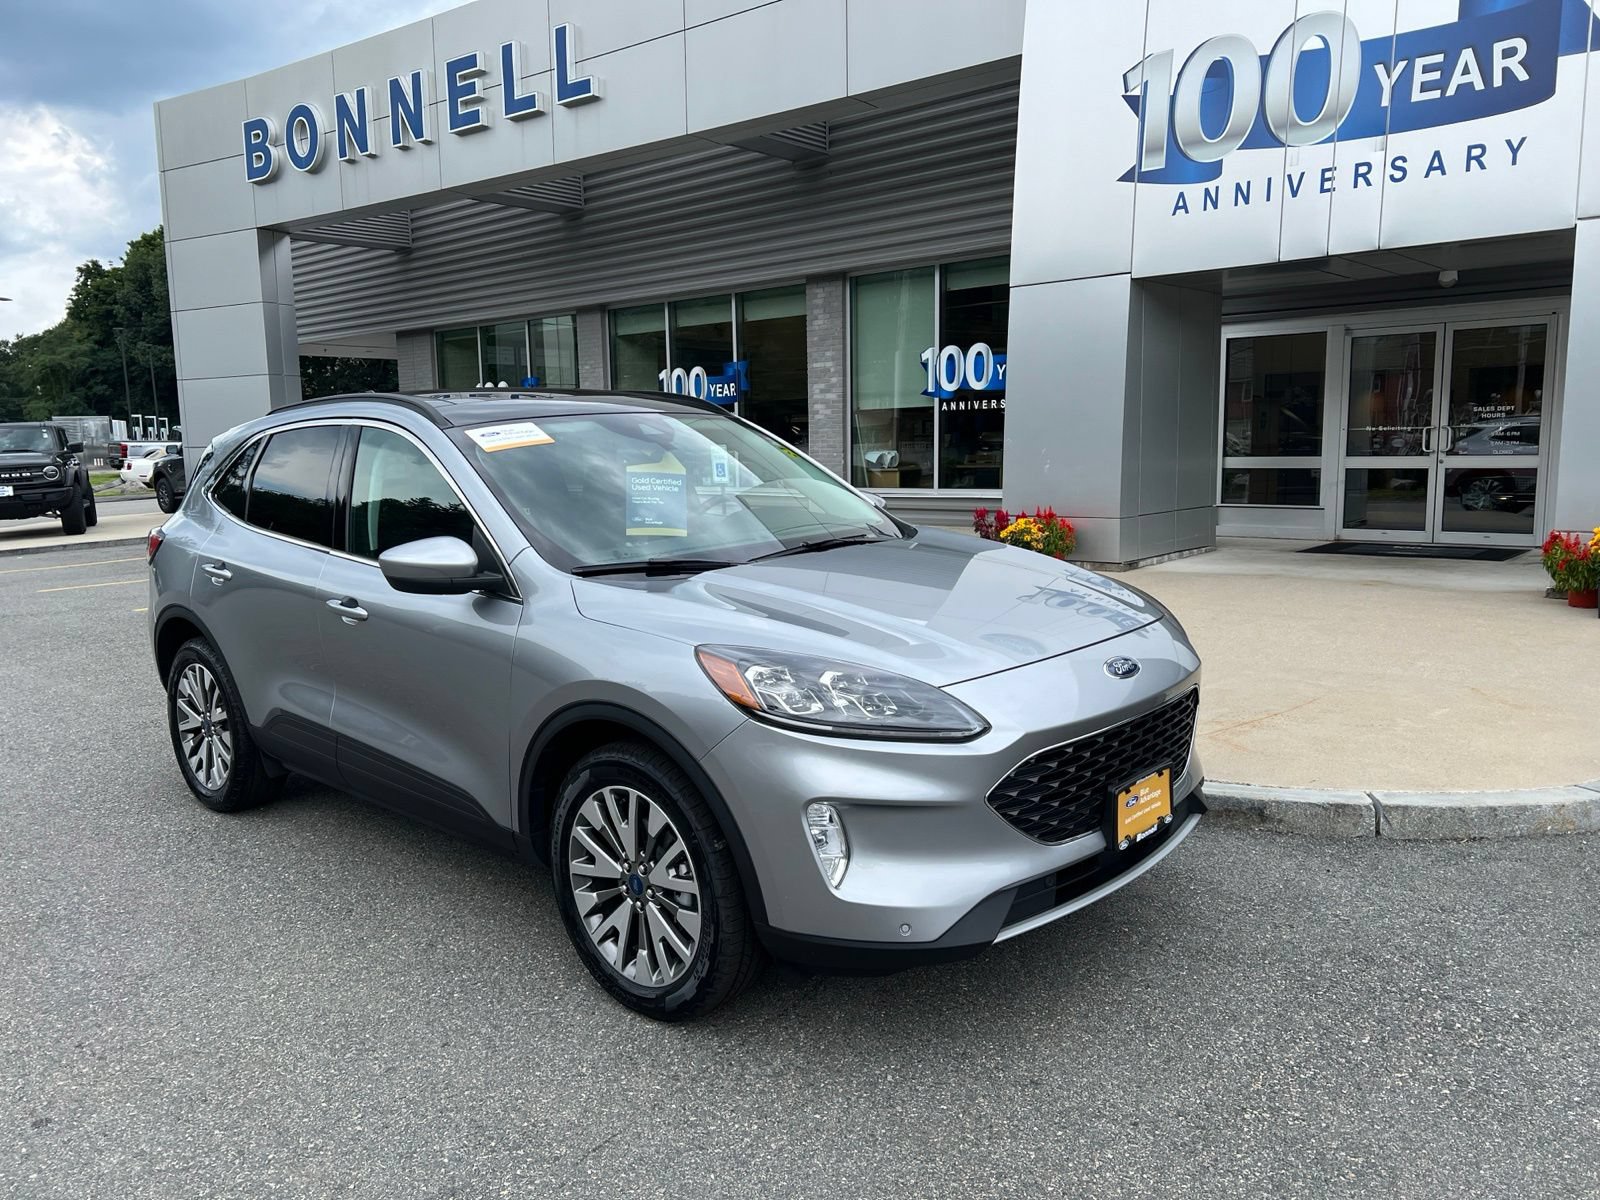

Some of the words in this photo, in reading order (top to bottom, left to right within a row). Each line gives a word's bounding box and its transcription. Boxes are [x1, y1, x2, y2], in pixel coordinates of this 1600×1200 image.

[242, 22, 600, 183] BONNELL
[1122, 10, 1362, 172] 100
[1374, 37, 1530, 107] YEAR
[1172, 136, 1528, 216] ANNIVERSARY
[659, 366, 708, 400] 100
[709, 382, 737, 398] YEAR
[921, 342, 993, 393] 100
[941, 399, 1006, 412] ANNIVERS
[650, 477, 682, 486] Certified
[652, 484, 679, 492] Vehicle
